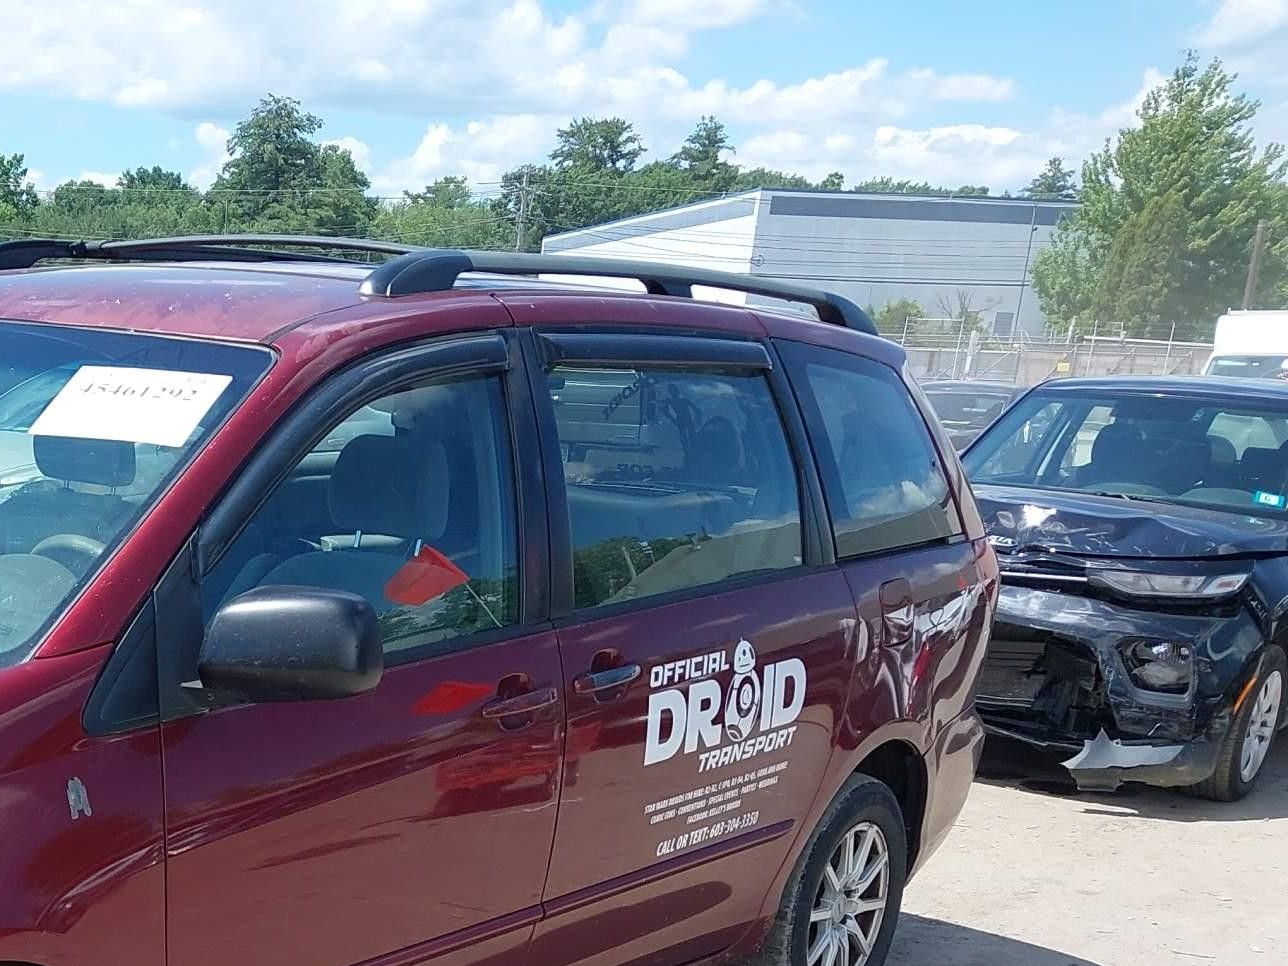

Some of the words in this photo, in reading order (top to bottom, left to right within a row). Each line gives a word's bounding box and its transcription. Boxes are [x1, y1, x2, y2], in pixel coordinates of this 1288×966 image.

[650, 650, 730, 688] OFFICIAL
[698, 726, 797, 773] TRANSPORT
[656, 838, 676, 857] CALL
[676, 833, 689, 850] OR
[689, 826, 709, 846] TEXT:
[709, 810, 760, 838] 603-304-3350
